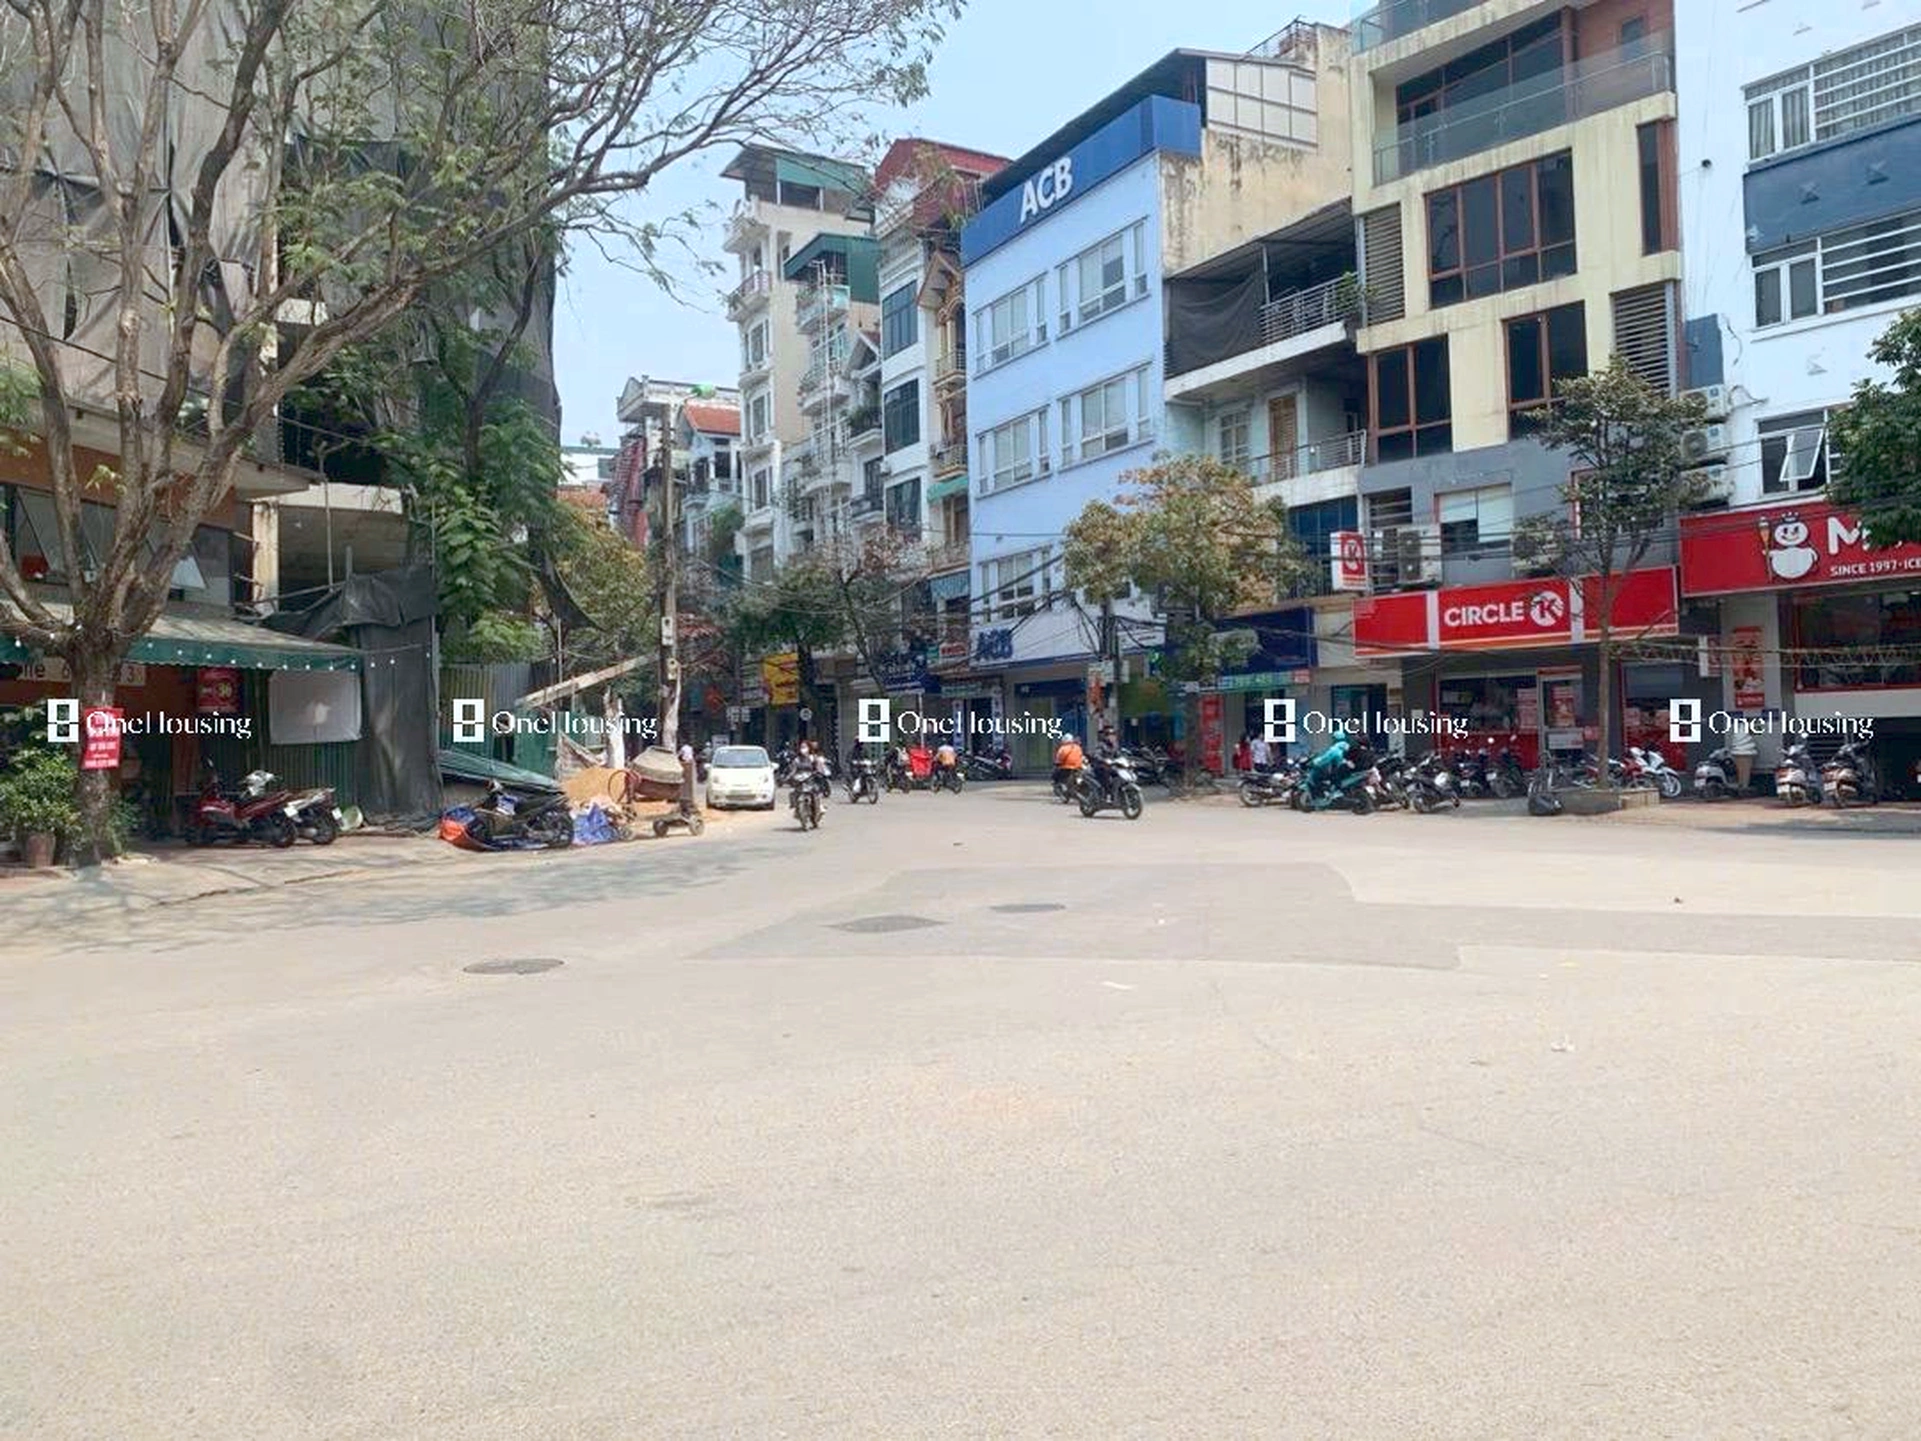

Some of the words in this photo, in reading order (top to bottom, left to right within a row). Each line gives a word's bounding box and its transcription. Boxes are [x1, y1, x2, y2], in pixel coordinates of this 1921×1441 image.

[1020, 157, 1073, 223] ACB
[1830, 563, 1867, 577] SINCE
[1444, 601, 1525, 627] CIRCLE
